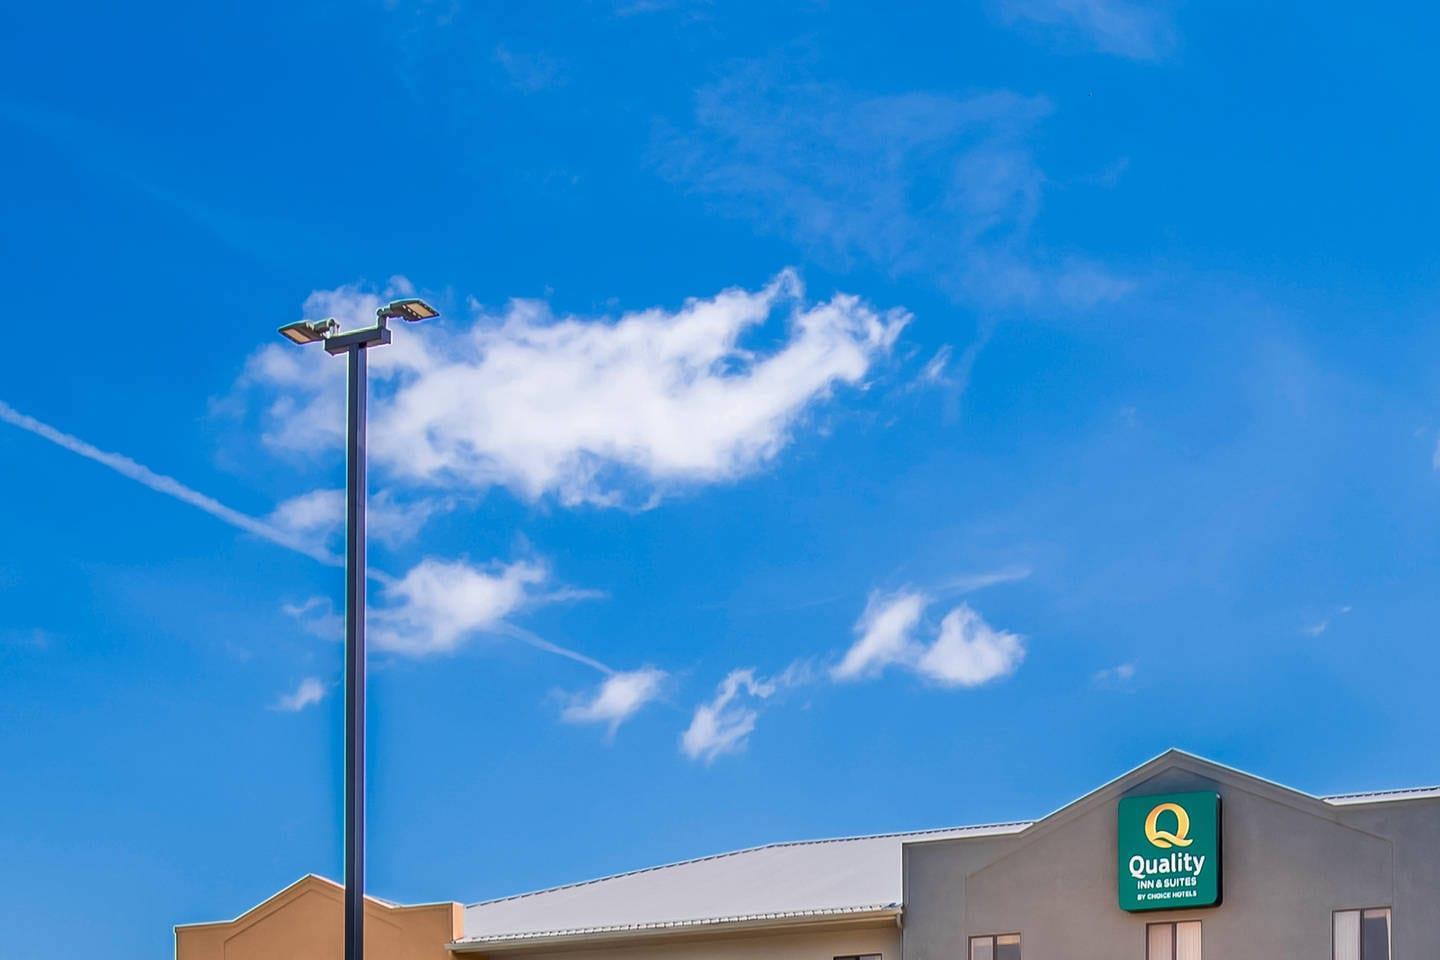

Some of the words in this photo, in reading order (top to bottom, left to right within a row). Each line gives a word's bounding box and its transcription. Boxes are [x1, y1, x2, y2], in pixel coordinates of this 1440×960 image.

[1144, 802, 1194, 848] Q
[1128, 852, 1205, 879] Quality
[1137, 879, 1155, 890] INN
[1155, 879, 1163, 888] &
[1163, 876, 1197, 888] SUITES
[1137, 893, 1146, 901] BY
[1146, 891, 1171, 900] CHOICE
[1172, 890, 1197, 898] HOTELS
